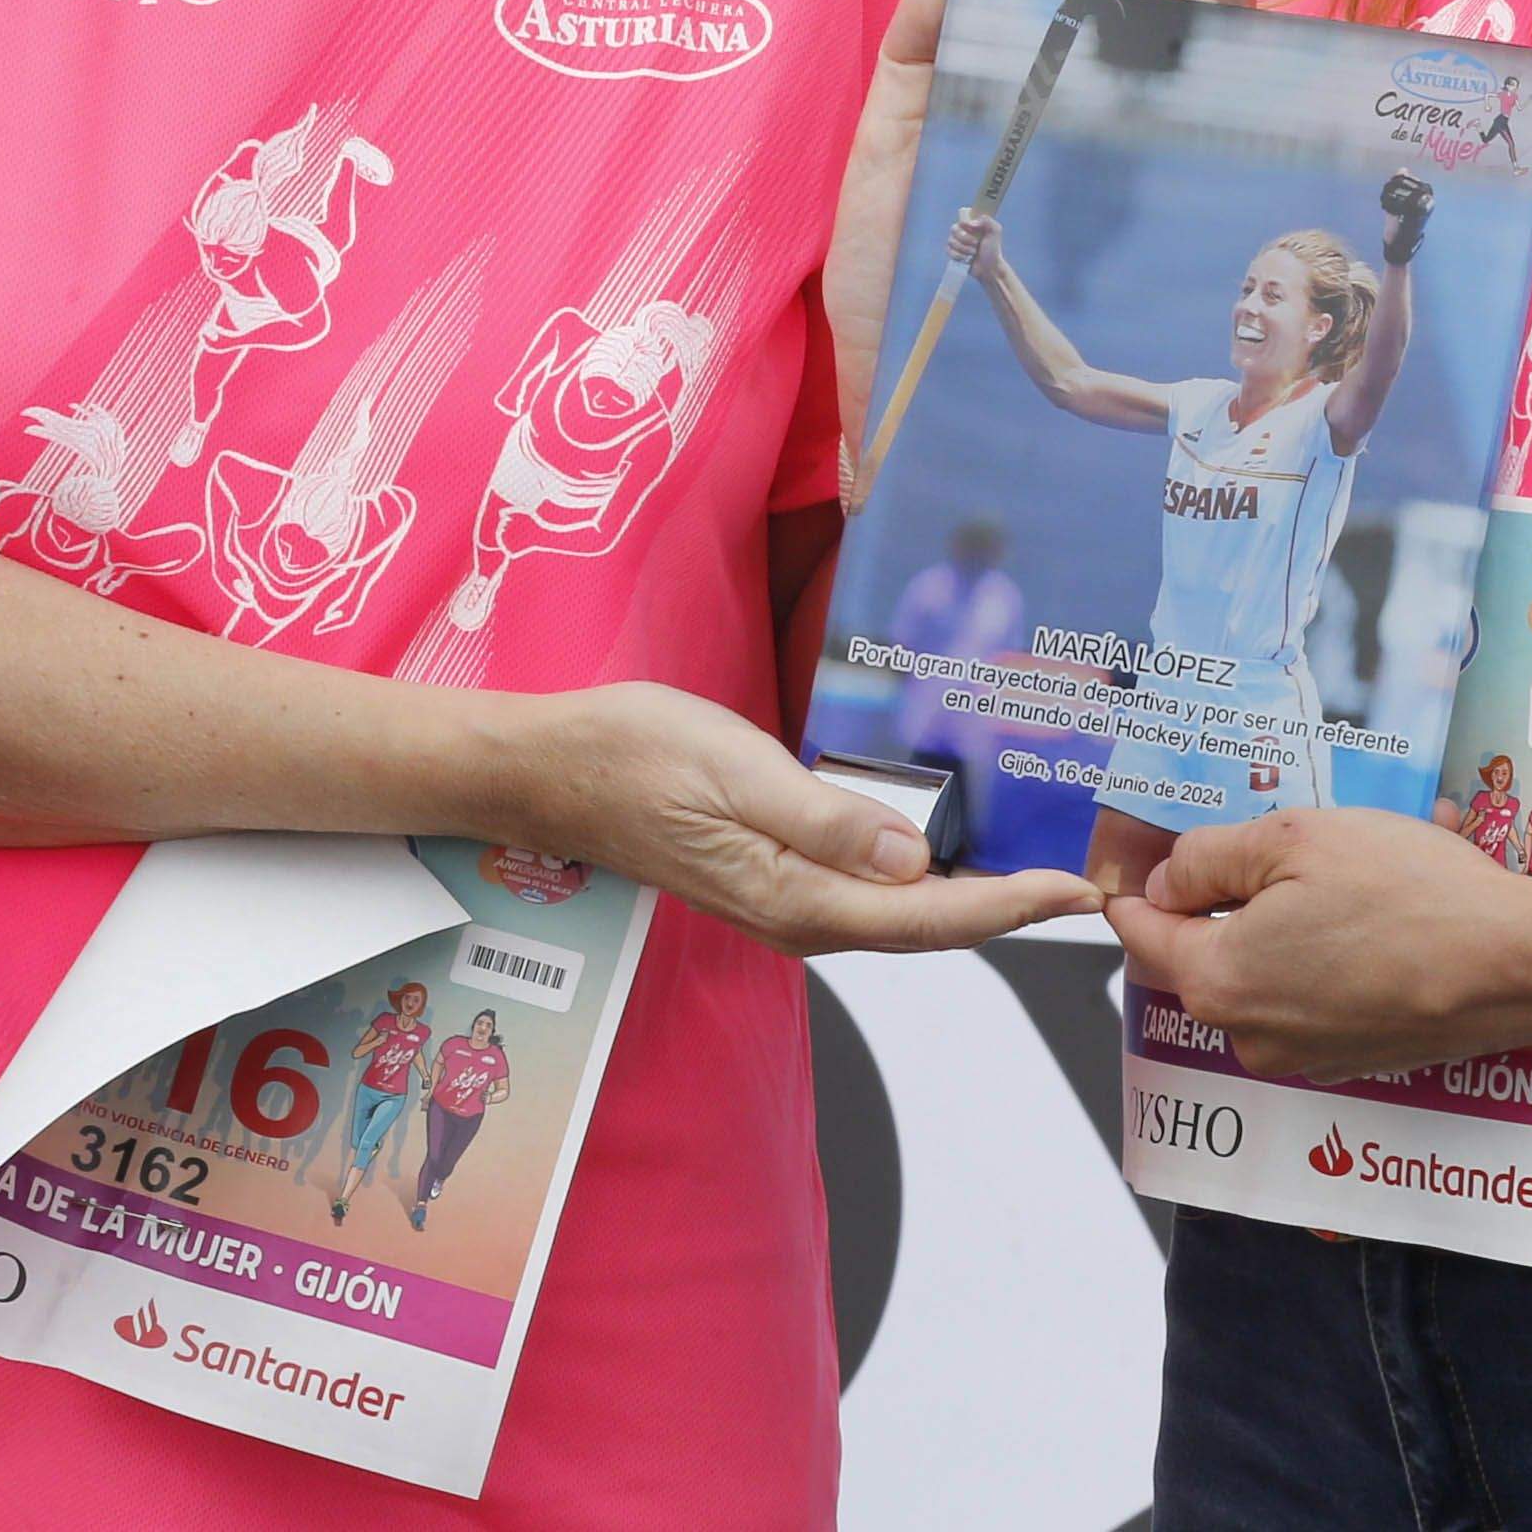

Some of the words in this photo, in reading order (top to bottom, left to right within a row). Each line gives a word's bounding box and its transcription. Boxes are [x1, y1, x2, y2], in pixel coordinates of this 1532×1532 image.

[1375, 92, 1463, 128] Carrera
[1391, 124, 1408, 142] de
[1411, 124, 1422, 143] la
[1419, 127, 1489, 170] Mujer
[1035, 630, 1127, 670] MARÍA
[1137, 644, 1236, 687] LÓPEZ
[851, 640, 889, 664] Por
[893, 648, 911, 667] tu
[918, 656, 963, 677] gran
[971, 662, 1076, 696] trayectoria
[1084, 682, 1177, 714] deportiva
[1186, 703, 1197, 720] y
[1203, 705, 1238, 724] por
[1244, 712, 1276, 731] ser
[1283, 720, 1307, 737] un
[1317, 724, 1409, 755] referente
[946, 693, 969, 709] en
[977, 695, 995, 713] el
[1002, 702, 1071, 728] mundo
[1078, 712, 1108, 733] del
[1116, 718, 1193, 752] Hockey
[1200, 733, 1300, 768] femenino.
[1001, 753, 1049, 779] Gijón,
[1057, 762, 1076, 779] 16
[1082, 768, 1103, 785] de
[1107, 772, 1148, 793] junio
[1154, 780, 1175, 798] de
[1180, 785, 1223, 806] 2024
[1142, 1004, 1225, 1054] CARRERA
[112, 1110, 196, 1147] VIOLENCIA
[200, 1137, 220, 1153] DE
[71, 1125, 208, 1206] 3162
[26, 1176, 75, 1223] DE
[80, 1197, 125, 1239] LA
[137, 1213, 263, 1281] MUJER
[295, 1260, 403, 1319] GIJÓN
[173, 1325, 405, 1421] Santander
